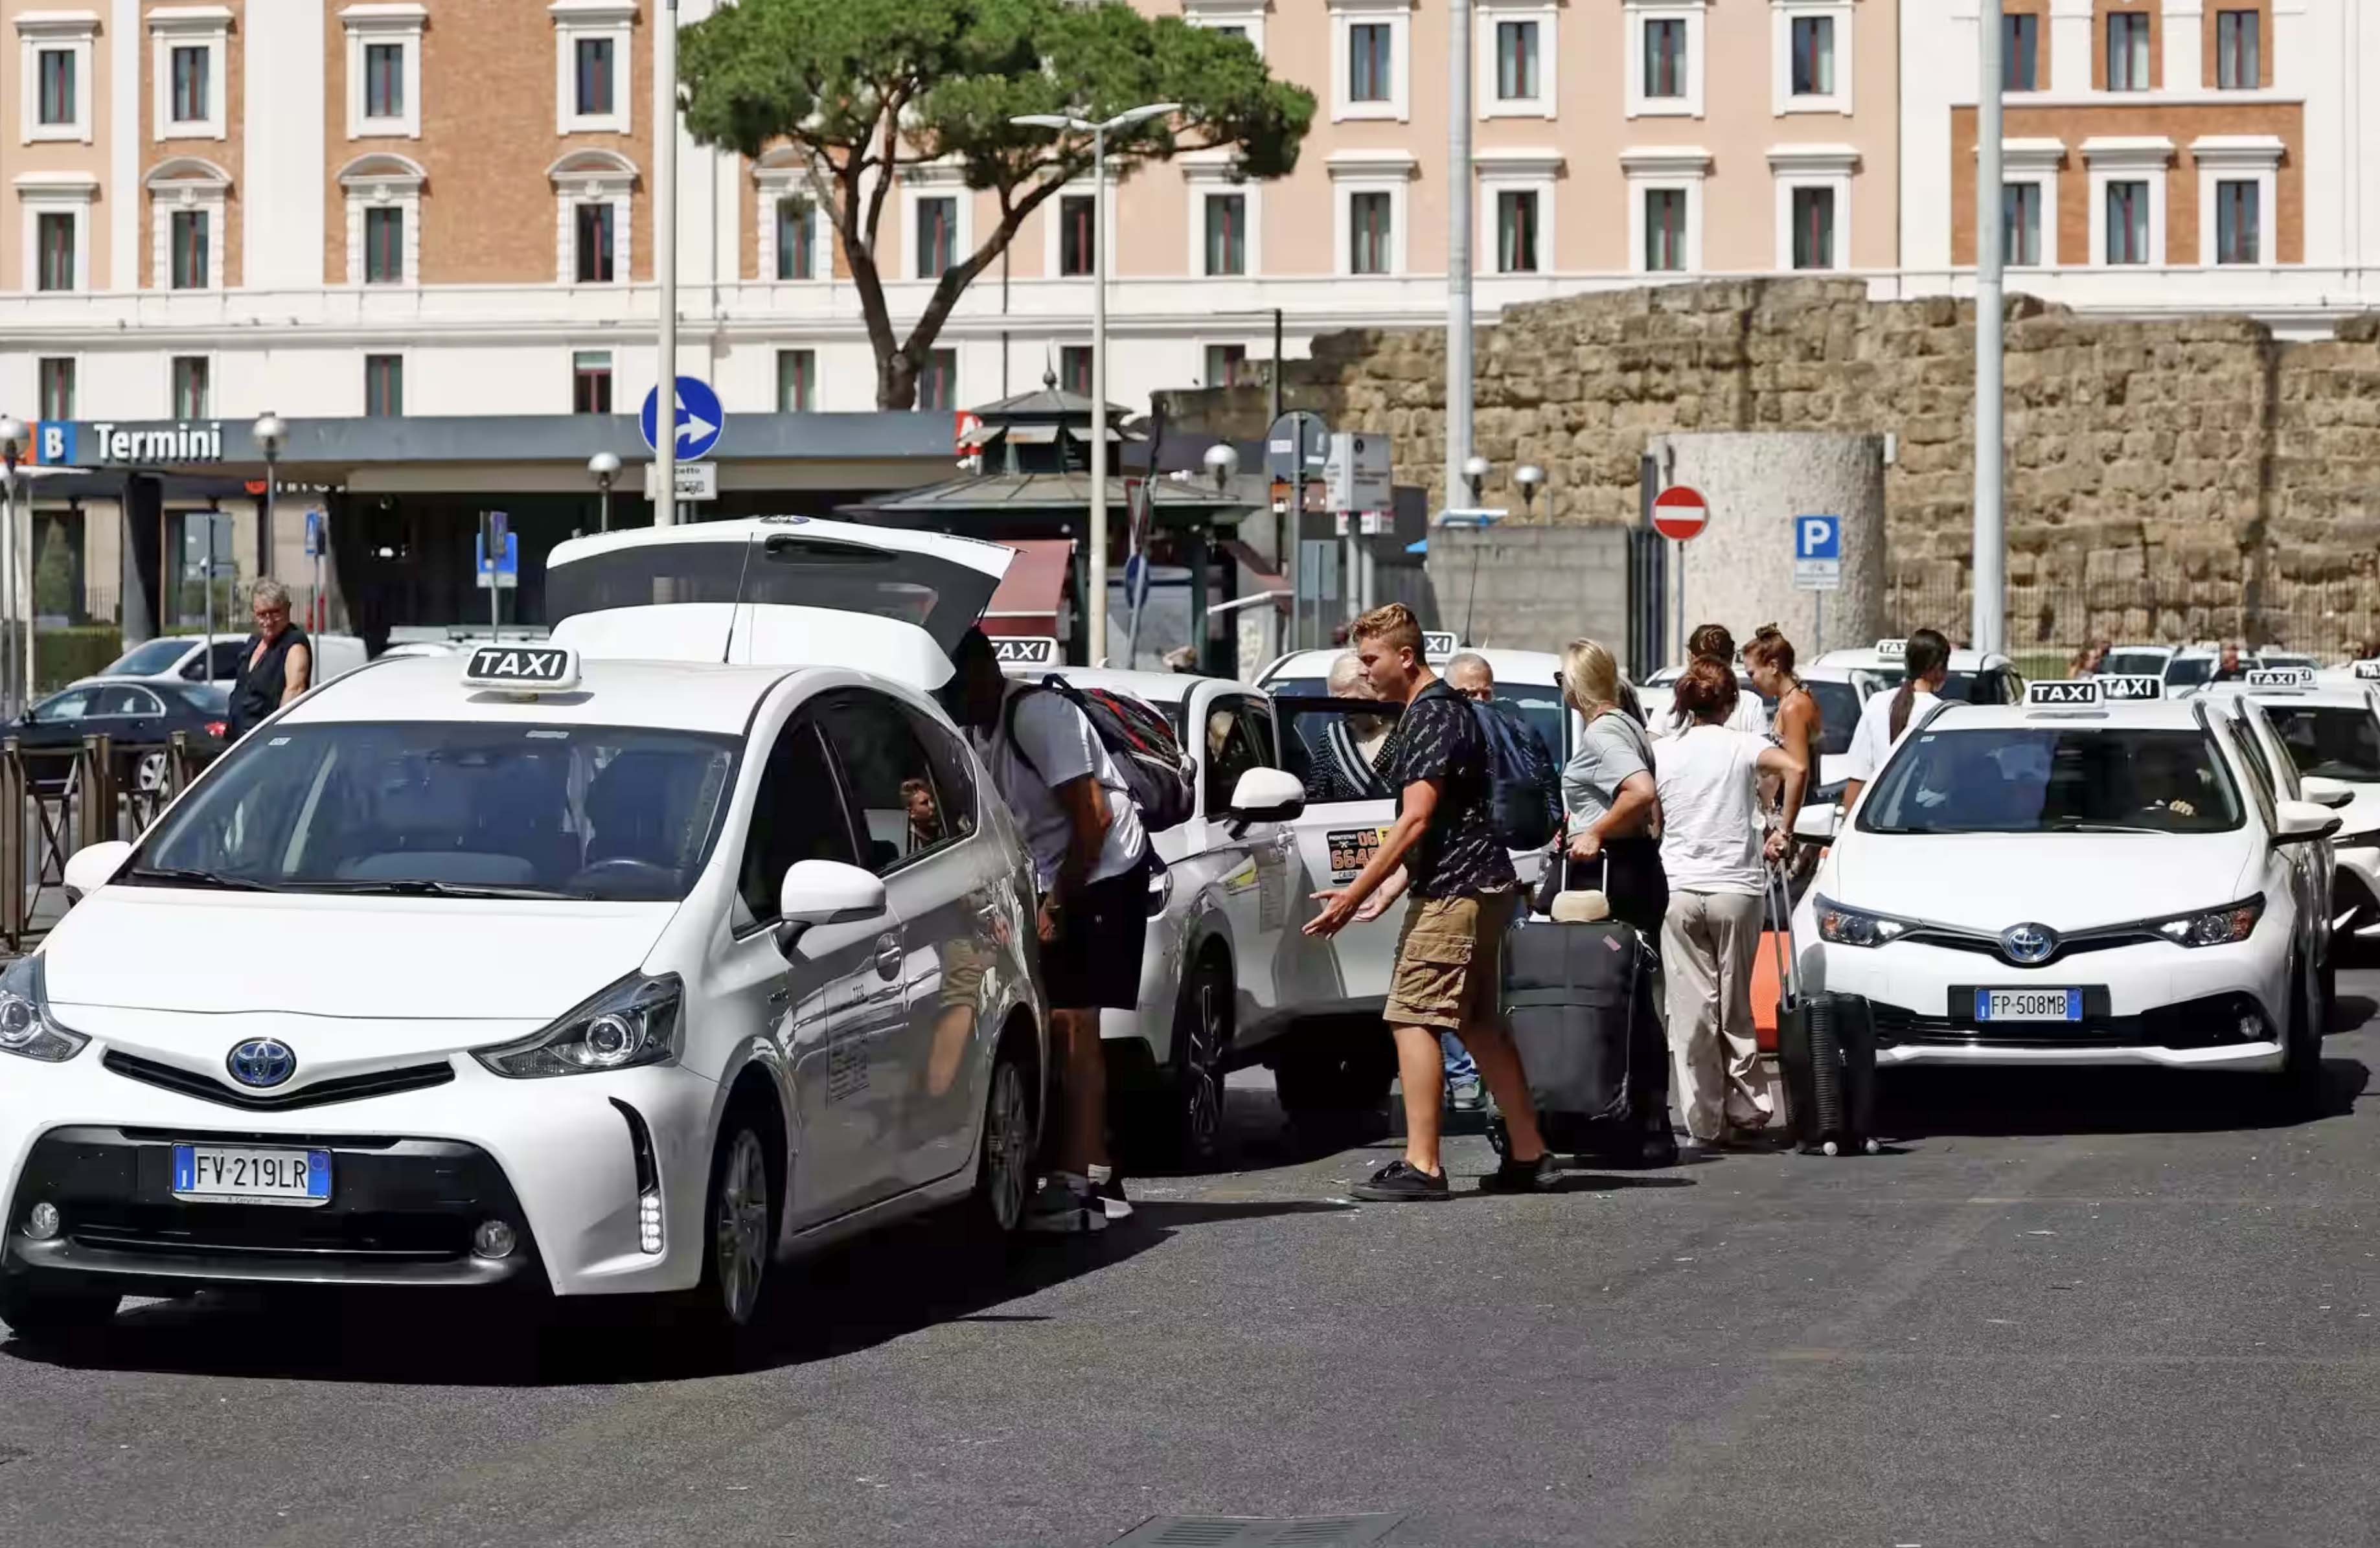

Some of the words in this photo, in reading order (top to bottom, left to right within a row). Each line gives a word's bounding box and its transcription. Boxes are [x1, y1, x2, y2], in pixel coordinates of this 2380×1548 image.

[44, 427, 64, 459] B
[94, 422, 221, 459] Termini
[1804, 520, 1831, 555] P
[991, 642, 1046, 660] AXI
[1426, 637, 1449, 652] XI
[478, 652, 562, 676] TAXI
[2103, 679, 2152, 696] TAXI
[2252, 674, 2294, 685] TAXI
[2032, 686, 2093, 701] TAXI
[1357, 831, 1378, 847] 06
